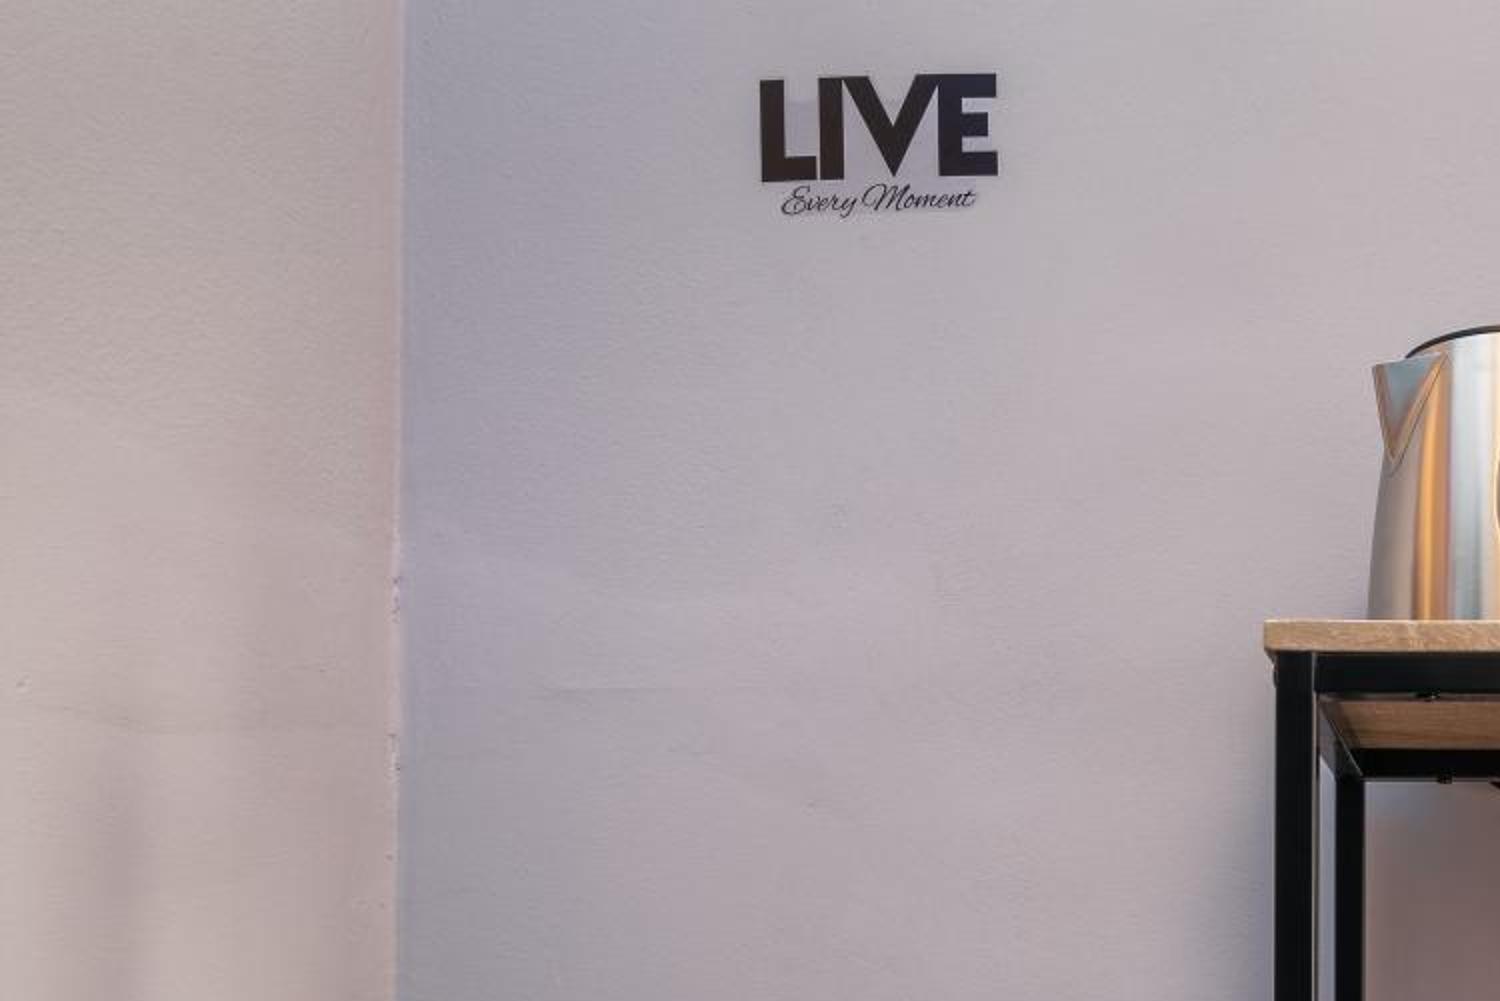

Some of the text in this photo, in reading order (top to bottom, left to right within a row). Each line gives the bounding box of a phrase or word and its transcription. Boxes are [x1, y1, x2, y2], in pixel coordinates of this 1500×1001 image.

[760, 74, 998, 182] LIVE
[781, 183, 976, 218] Every Moment
